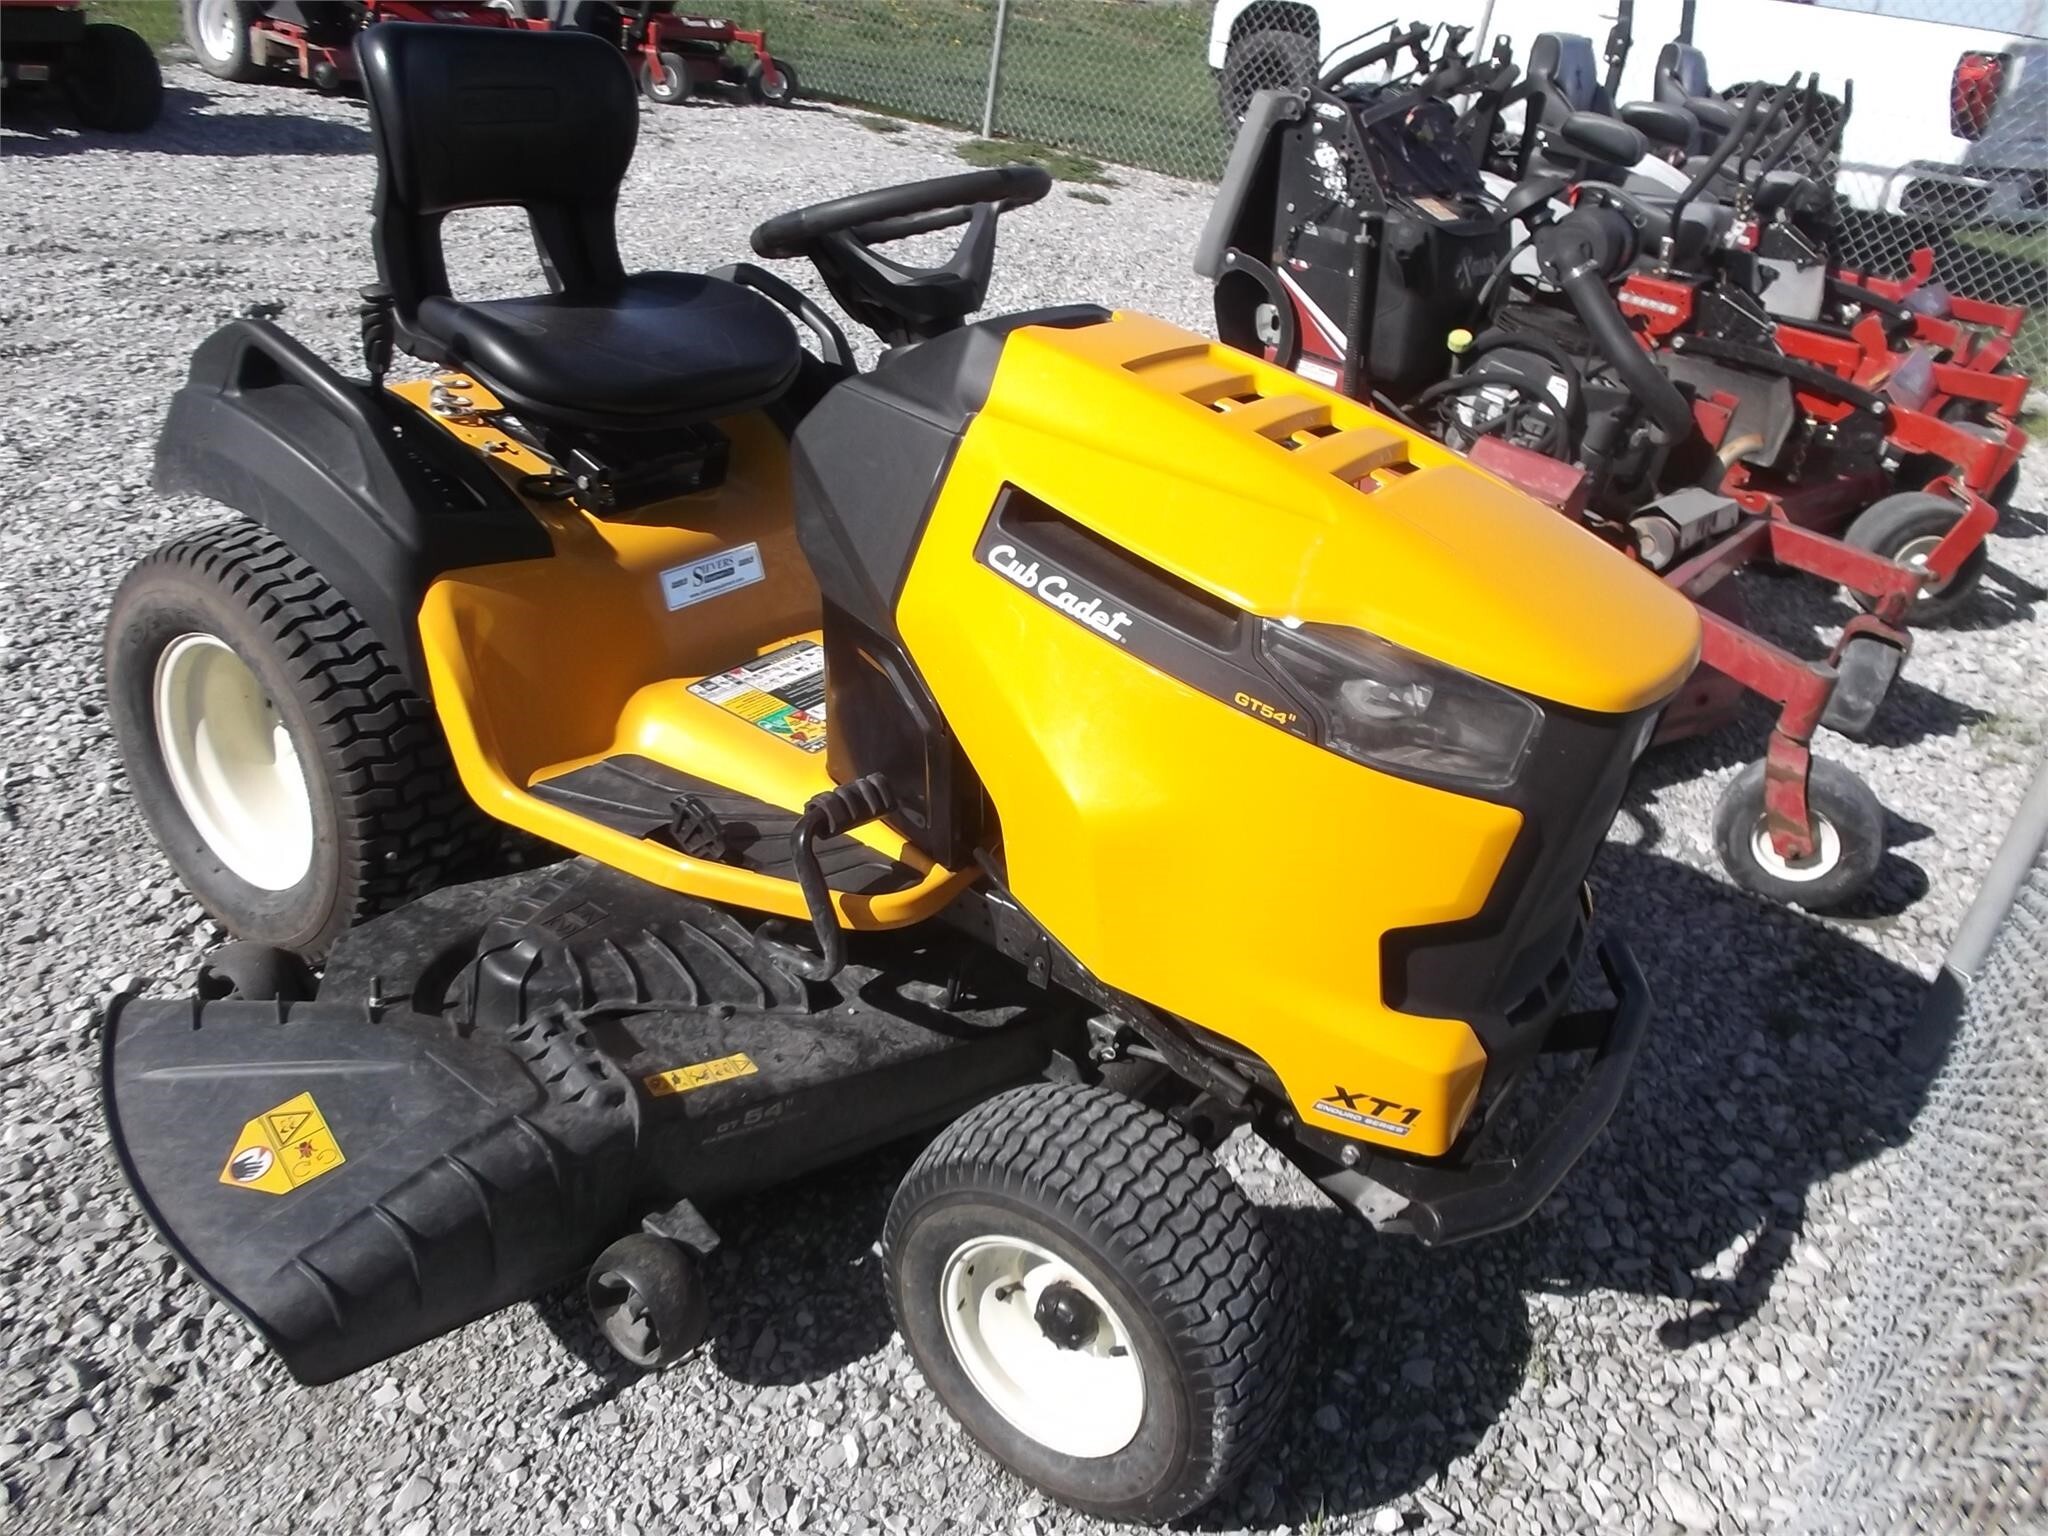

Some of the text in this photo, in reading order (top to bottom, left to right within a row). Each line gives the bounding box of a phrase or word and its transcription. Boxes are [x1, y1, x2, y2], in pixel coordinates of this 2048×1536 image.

[988, 544, 1133, 642] Cub Cadet
[1234, 691, 1297, 725] GT54"
[1315, 1102, 1405, 1134] ENDURO SERIES
[1320, 1084, 1422, 1125] XT1
